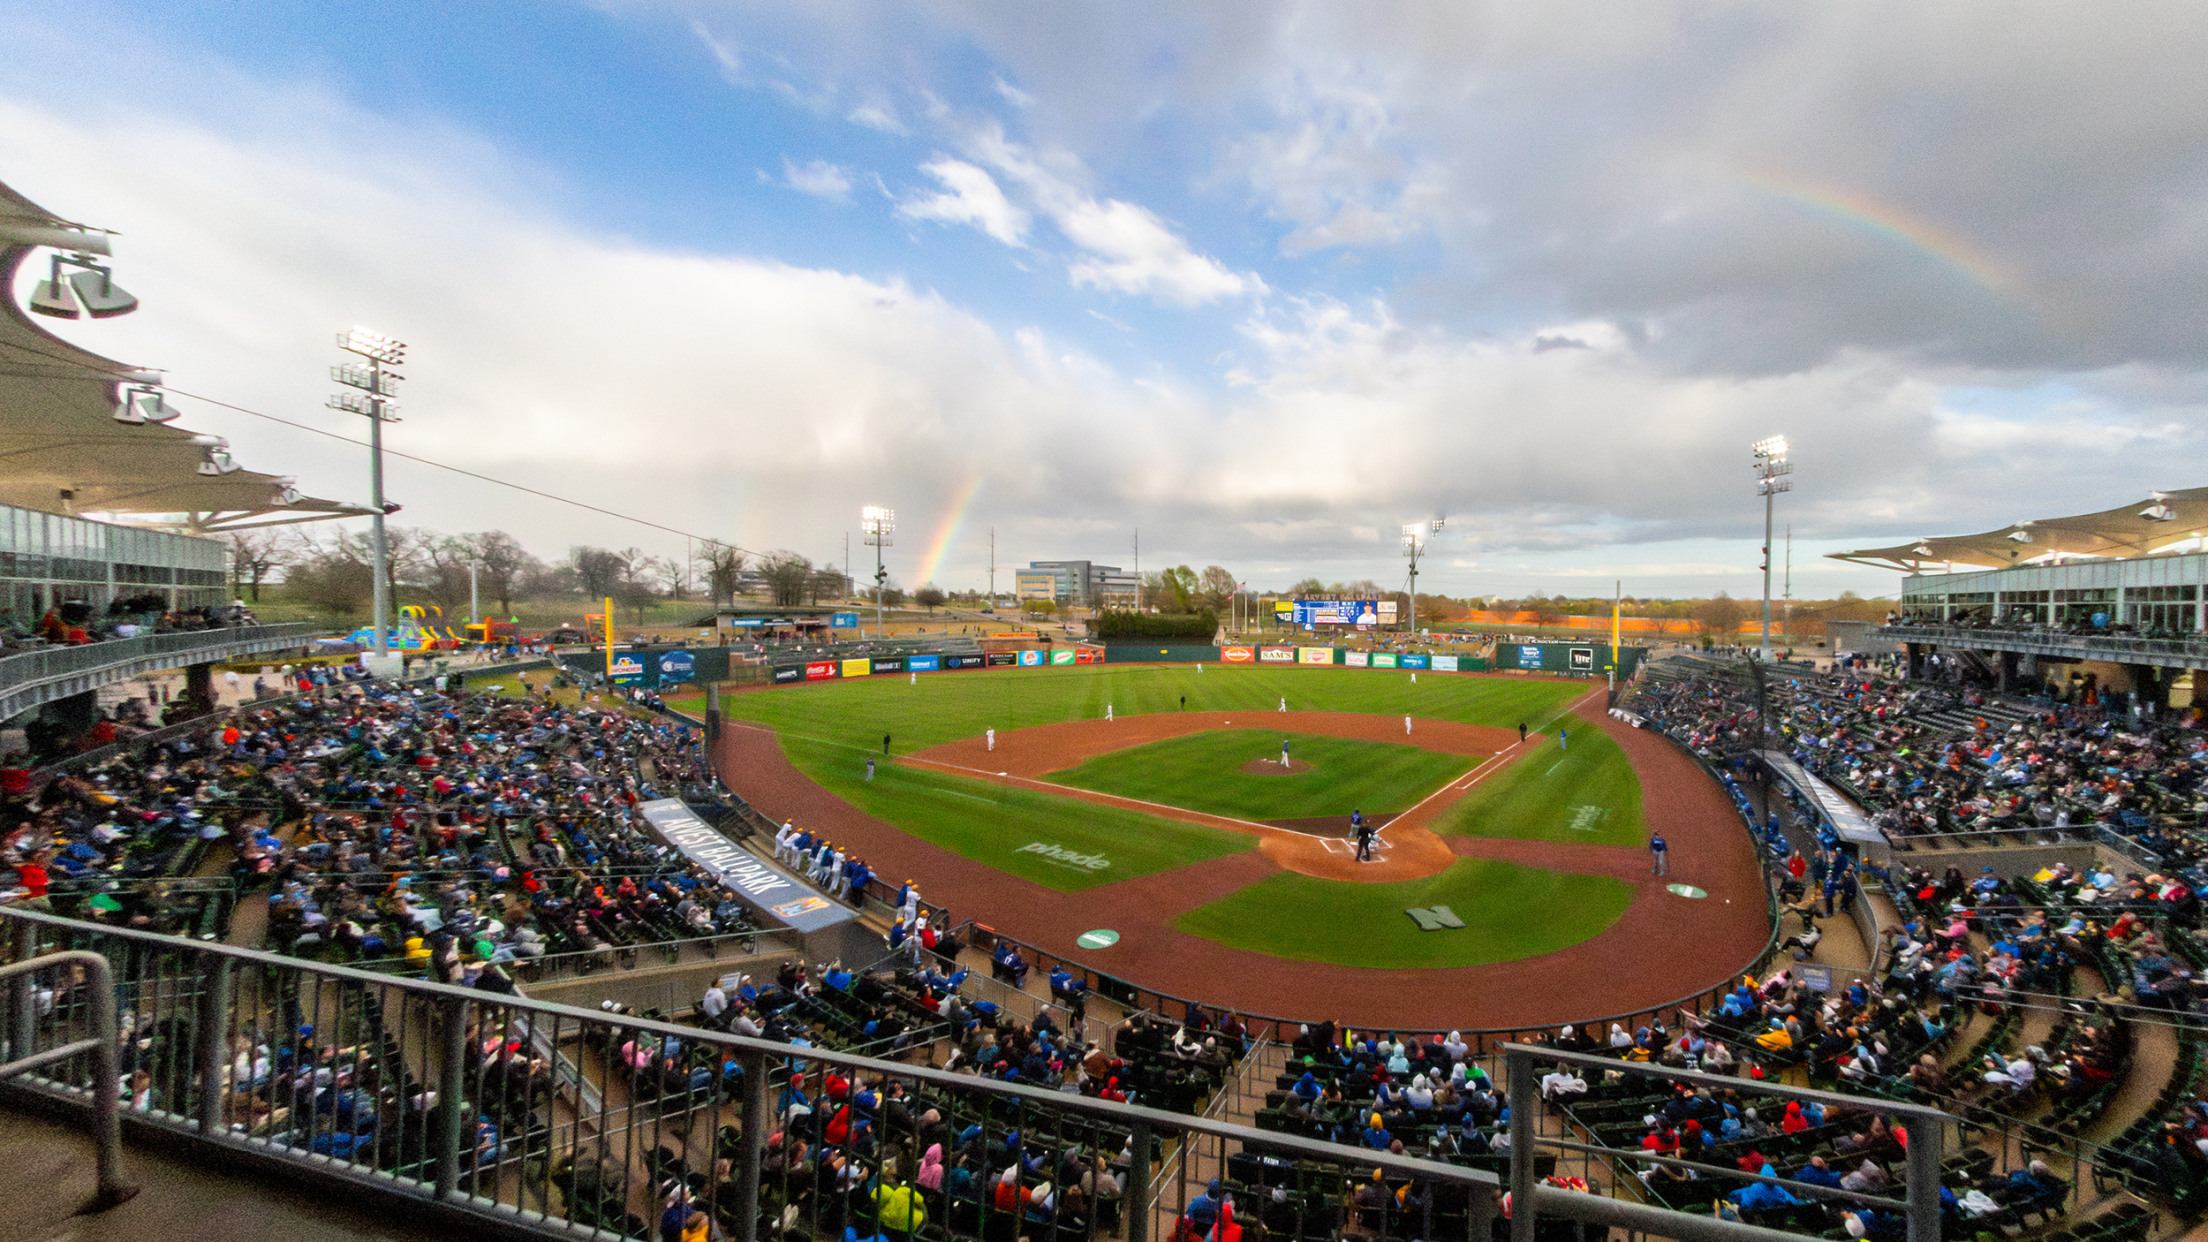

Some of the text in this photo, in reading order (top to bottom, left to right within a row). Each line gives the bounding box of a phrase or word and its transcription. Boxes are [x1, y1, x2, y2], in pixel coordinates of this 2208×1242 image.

[1262, 651, 1291, 659] SAM'S
[611, 666, 643, 674] WONDER
[660, 818, 791, 895] ARVEST BALLPARK
[1012, 842, 1111, 870] phade
